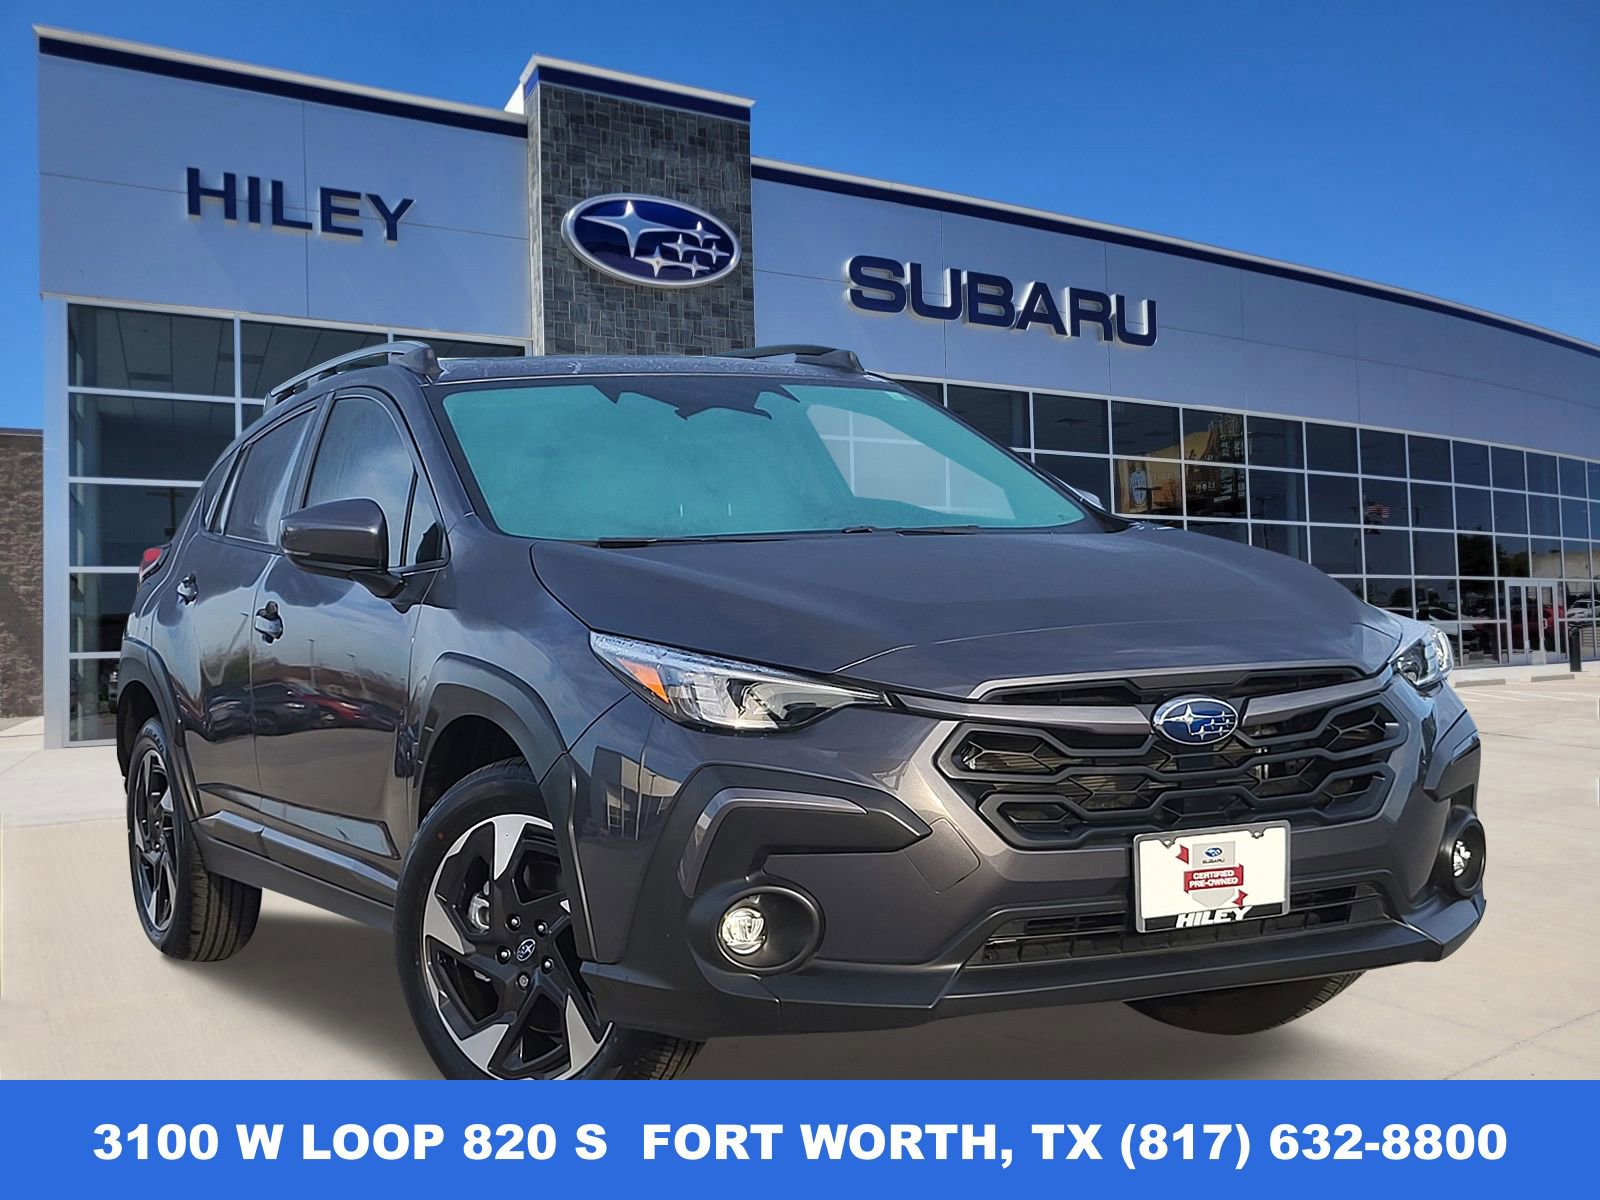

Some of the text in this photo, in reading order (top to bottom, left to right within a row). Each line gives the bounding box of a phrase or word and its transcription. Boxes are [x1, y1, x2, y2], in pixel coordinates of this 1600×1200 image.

[186, 167, 414, 242] HILEY
[847, 255, 1157, 347] SUBARU
[1189, 877, 1239, 889] PRE-OWNED
[1192, 869, 1235, 880] CERTIFIED
[1176, 906, 1253, 928] HILEY
